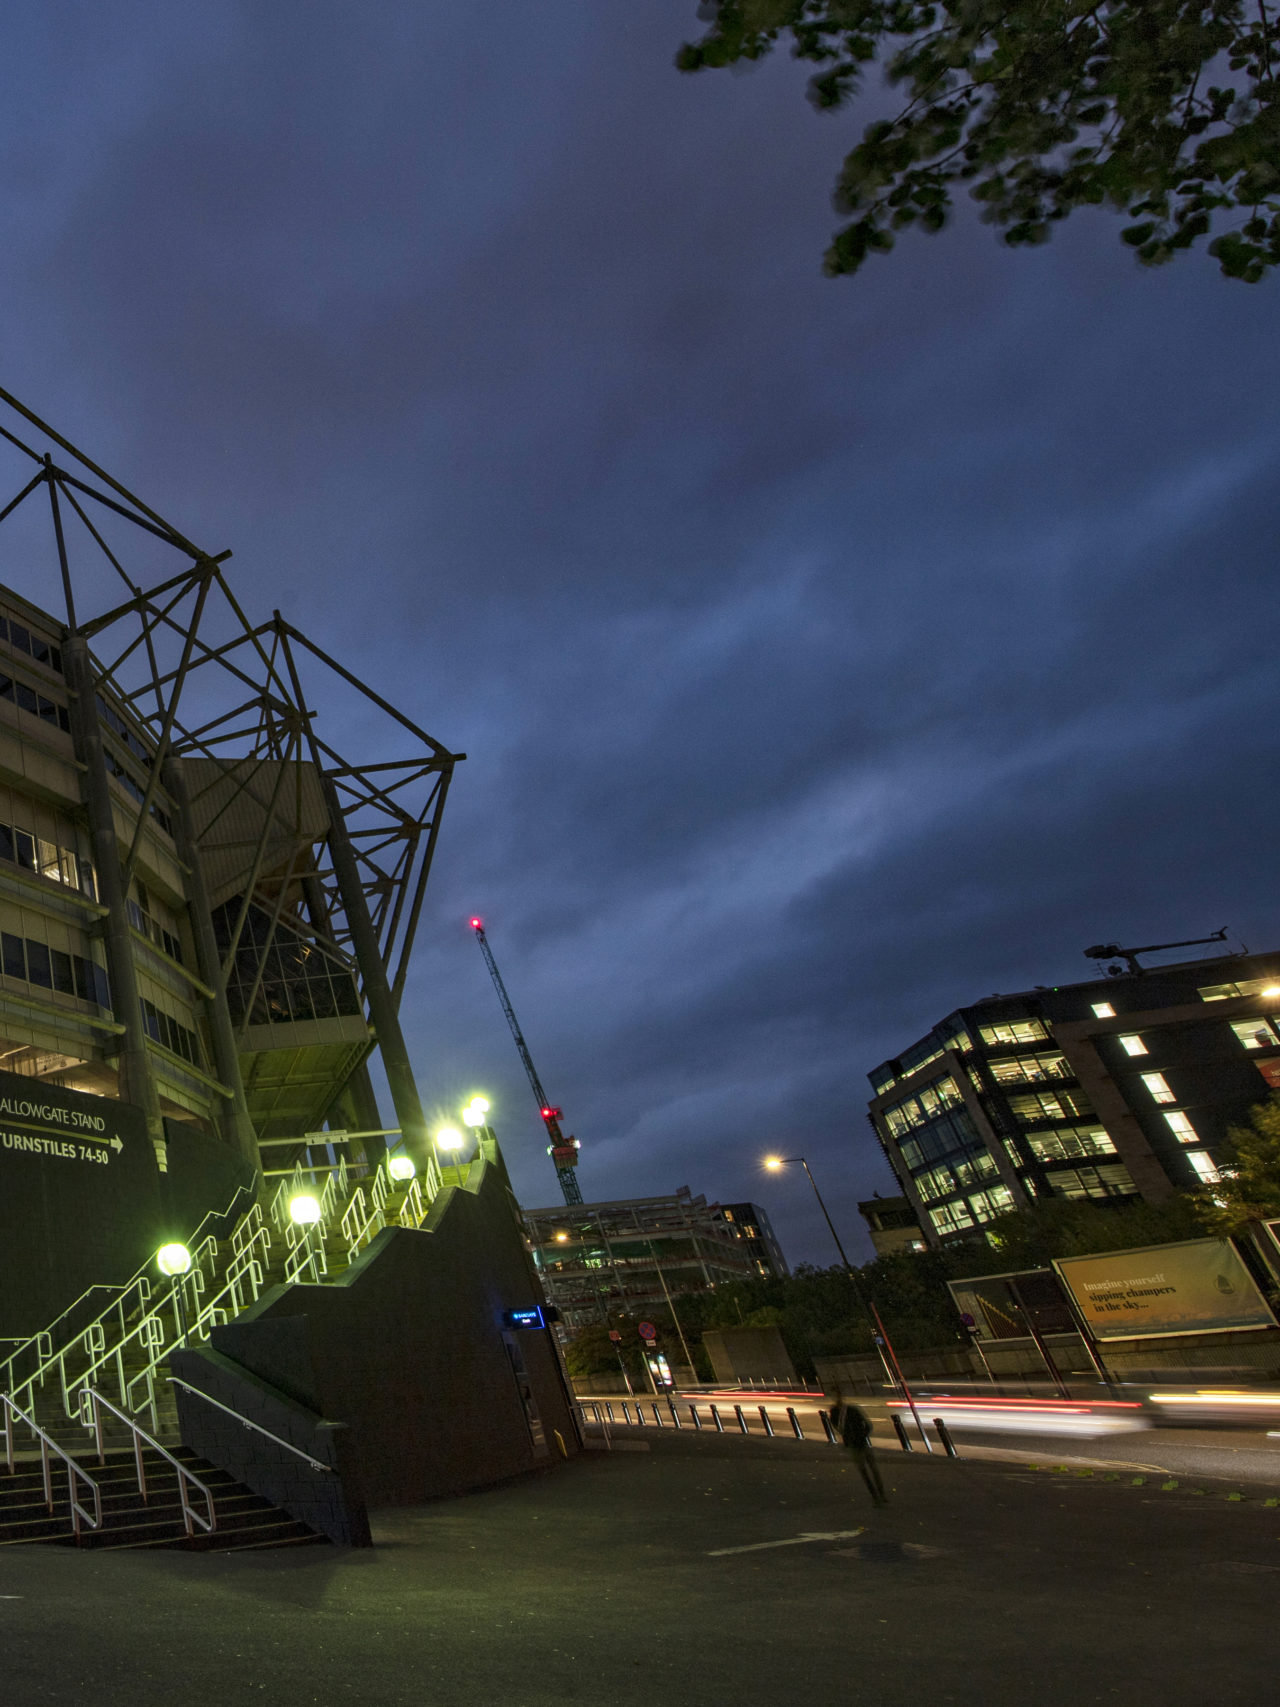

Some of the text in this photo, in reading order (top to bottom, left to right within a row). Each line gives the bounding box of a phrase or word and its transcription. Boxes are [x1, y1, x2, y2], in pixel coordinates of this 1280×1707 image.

[71, 1111, 106, 1131] STAND
[78, 1145, 109, 1165] 74-50
[1083, 1273, 1166, 1291] Imagine yourself
[1089, 1286, 1176, 1302] sipping champers
[1093, 1303, 1105, 1312] in
[1105, 1302, 1121, 1311] the
